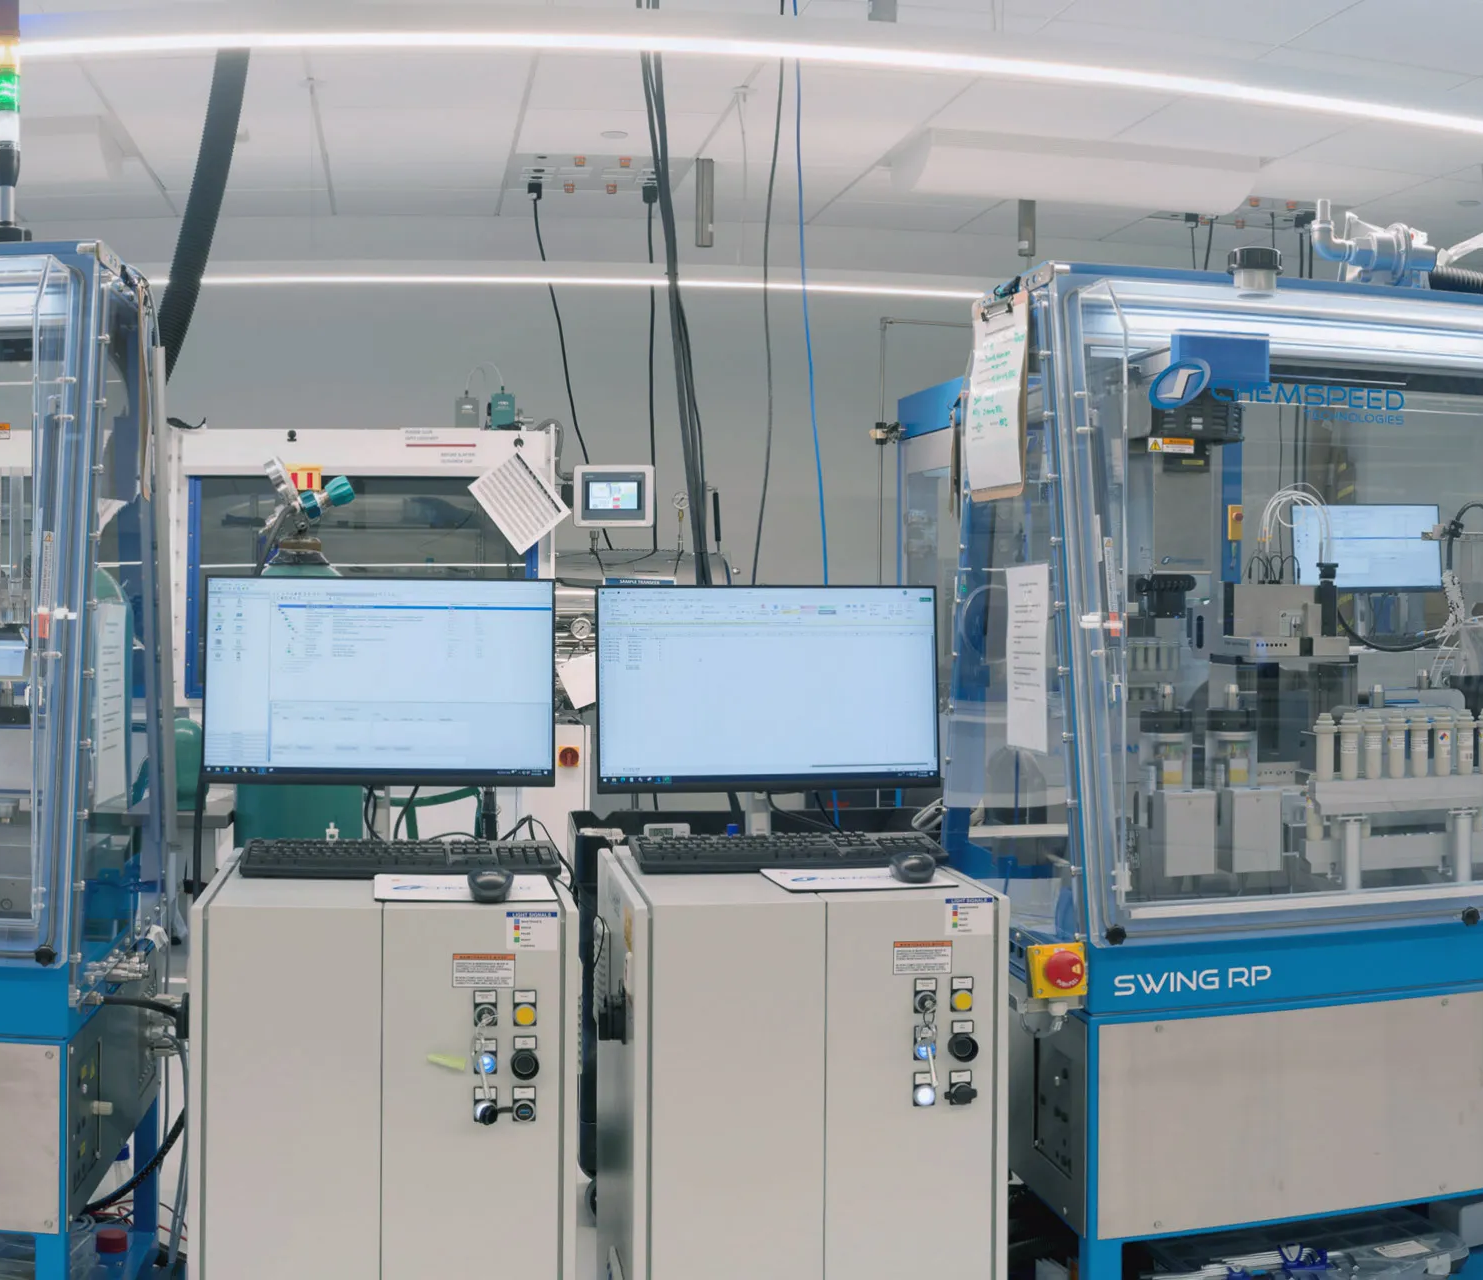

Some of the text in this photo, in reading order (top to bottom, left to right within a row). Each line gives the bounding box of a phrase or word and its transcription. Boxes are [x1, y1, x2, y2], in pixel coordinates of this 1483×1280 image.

[1211, 382, 1405, 411] CHEMSPEED
[1114, 965, 1272, 997] SWING RP
